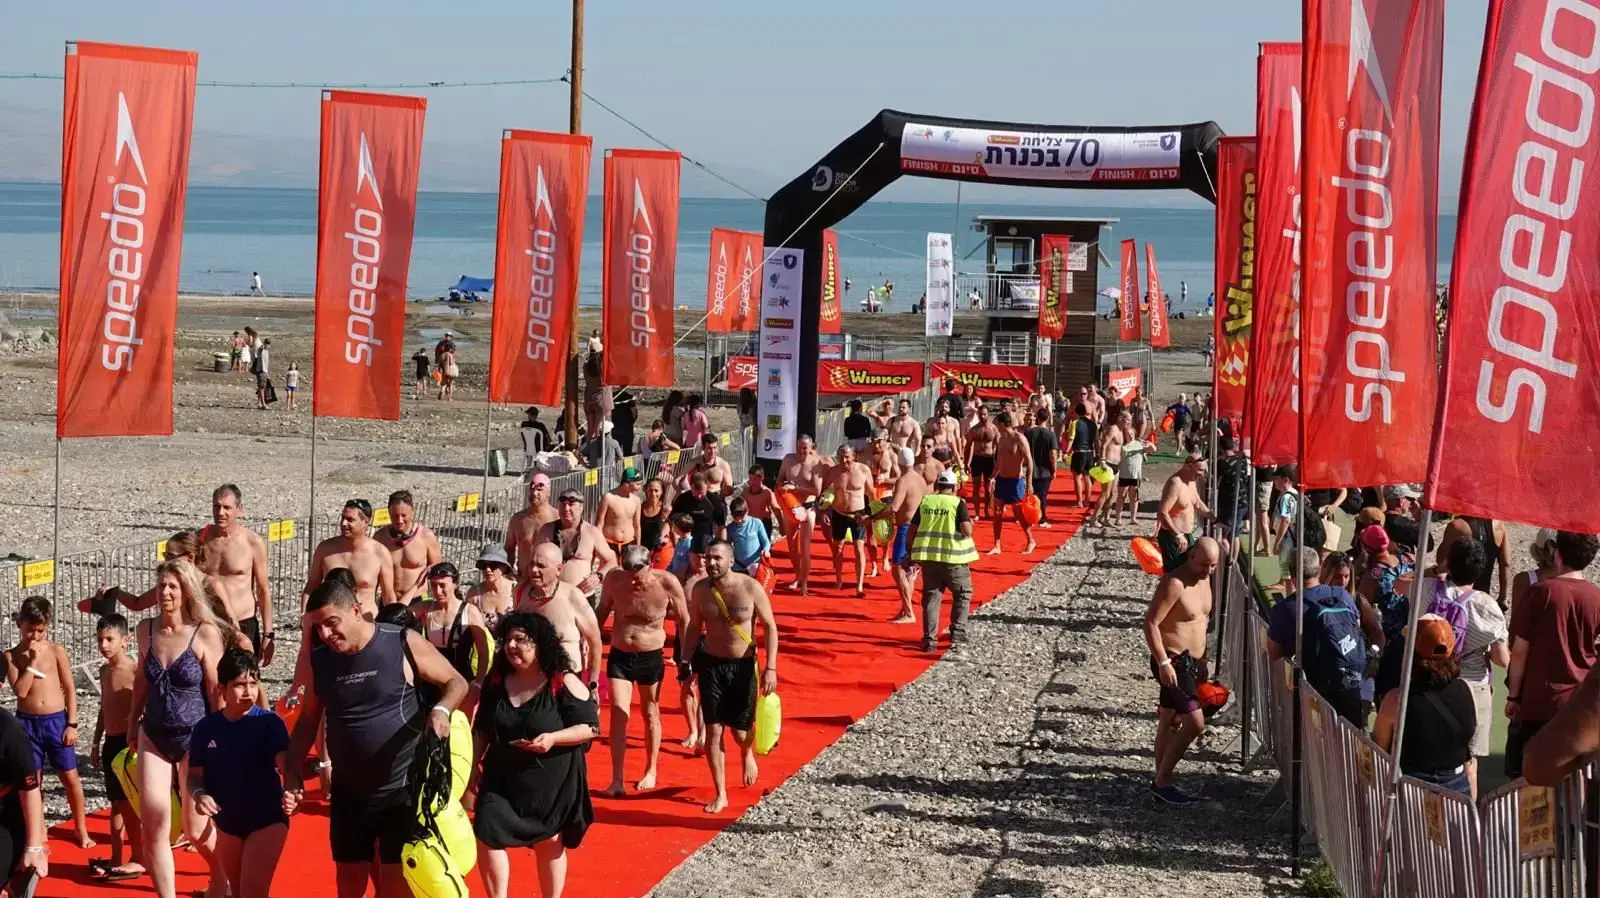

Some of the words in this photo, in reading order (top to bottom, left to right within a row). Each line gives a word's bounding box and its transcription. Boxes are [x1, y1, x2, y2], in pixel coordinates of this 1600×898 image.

[903, 159, 938, 171] FINISH
[984, 146, 1060, 167] בכנרת
[1021, 136, 1062, 146] צליחת
[1065, 139, 1099, 167] 70
[952, 165, 979, 174] סיום
[1100, 170, 1134, 179] FINISH
[1150, 169, 1178, 178] סיום
[1476, 0, 1600, 434] speedo
[100, 183, 146, 372] speedo
[344, 208, 383, 367] speedo
[525, 229, 556, 362] speedo
[625, 233, 657, 348] speedo
[713, 264, 728, 316] speedo
[739, 267, 754, 317] speedo
[823, 242, 836, 303] Winner
[1331, 128, 1405, 424] speedo
[1151, 280, 1163, 337] speedo
[849, 369, 911, 386] Winner
[961, 371, 1024, 389] Winner
